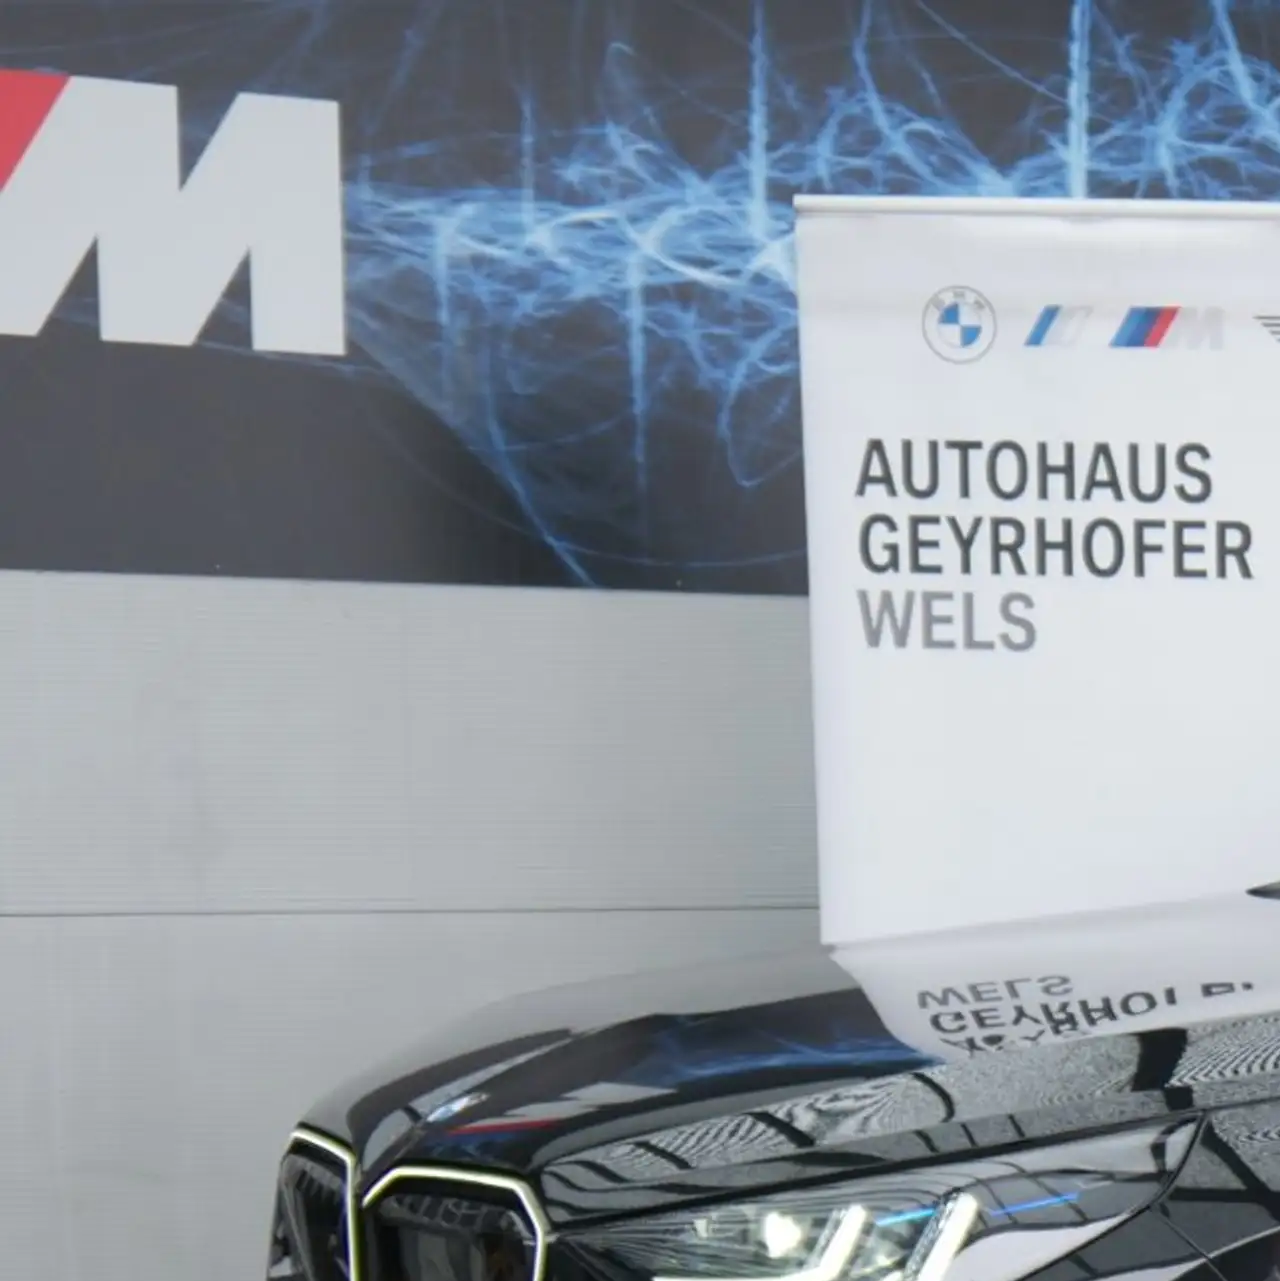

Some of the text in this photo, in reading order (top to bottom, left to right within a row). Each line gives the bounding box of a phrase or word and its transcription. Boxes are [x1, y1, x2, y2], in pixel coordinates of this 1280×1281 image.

[0, 75, 347, 356] M
[855, 438, 1213, 504] AUTOHAUS
[858, 513, 1254, 580] GEYRHOFER
[856, 589, 1037, 653] WELS
